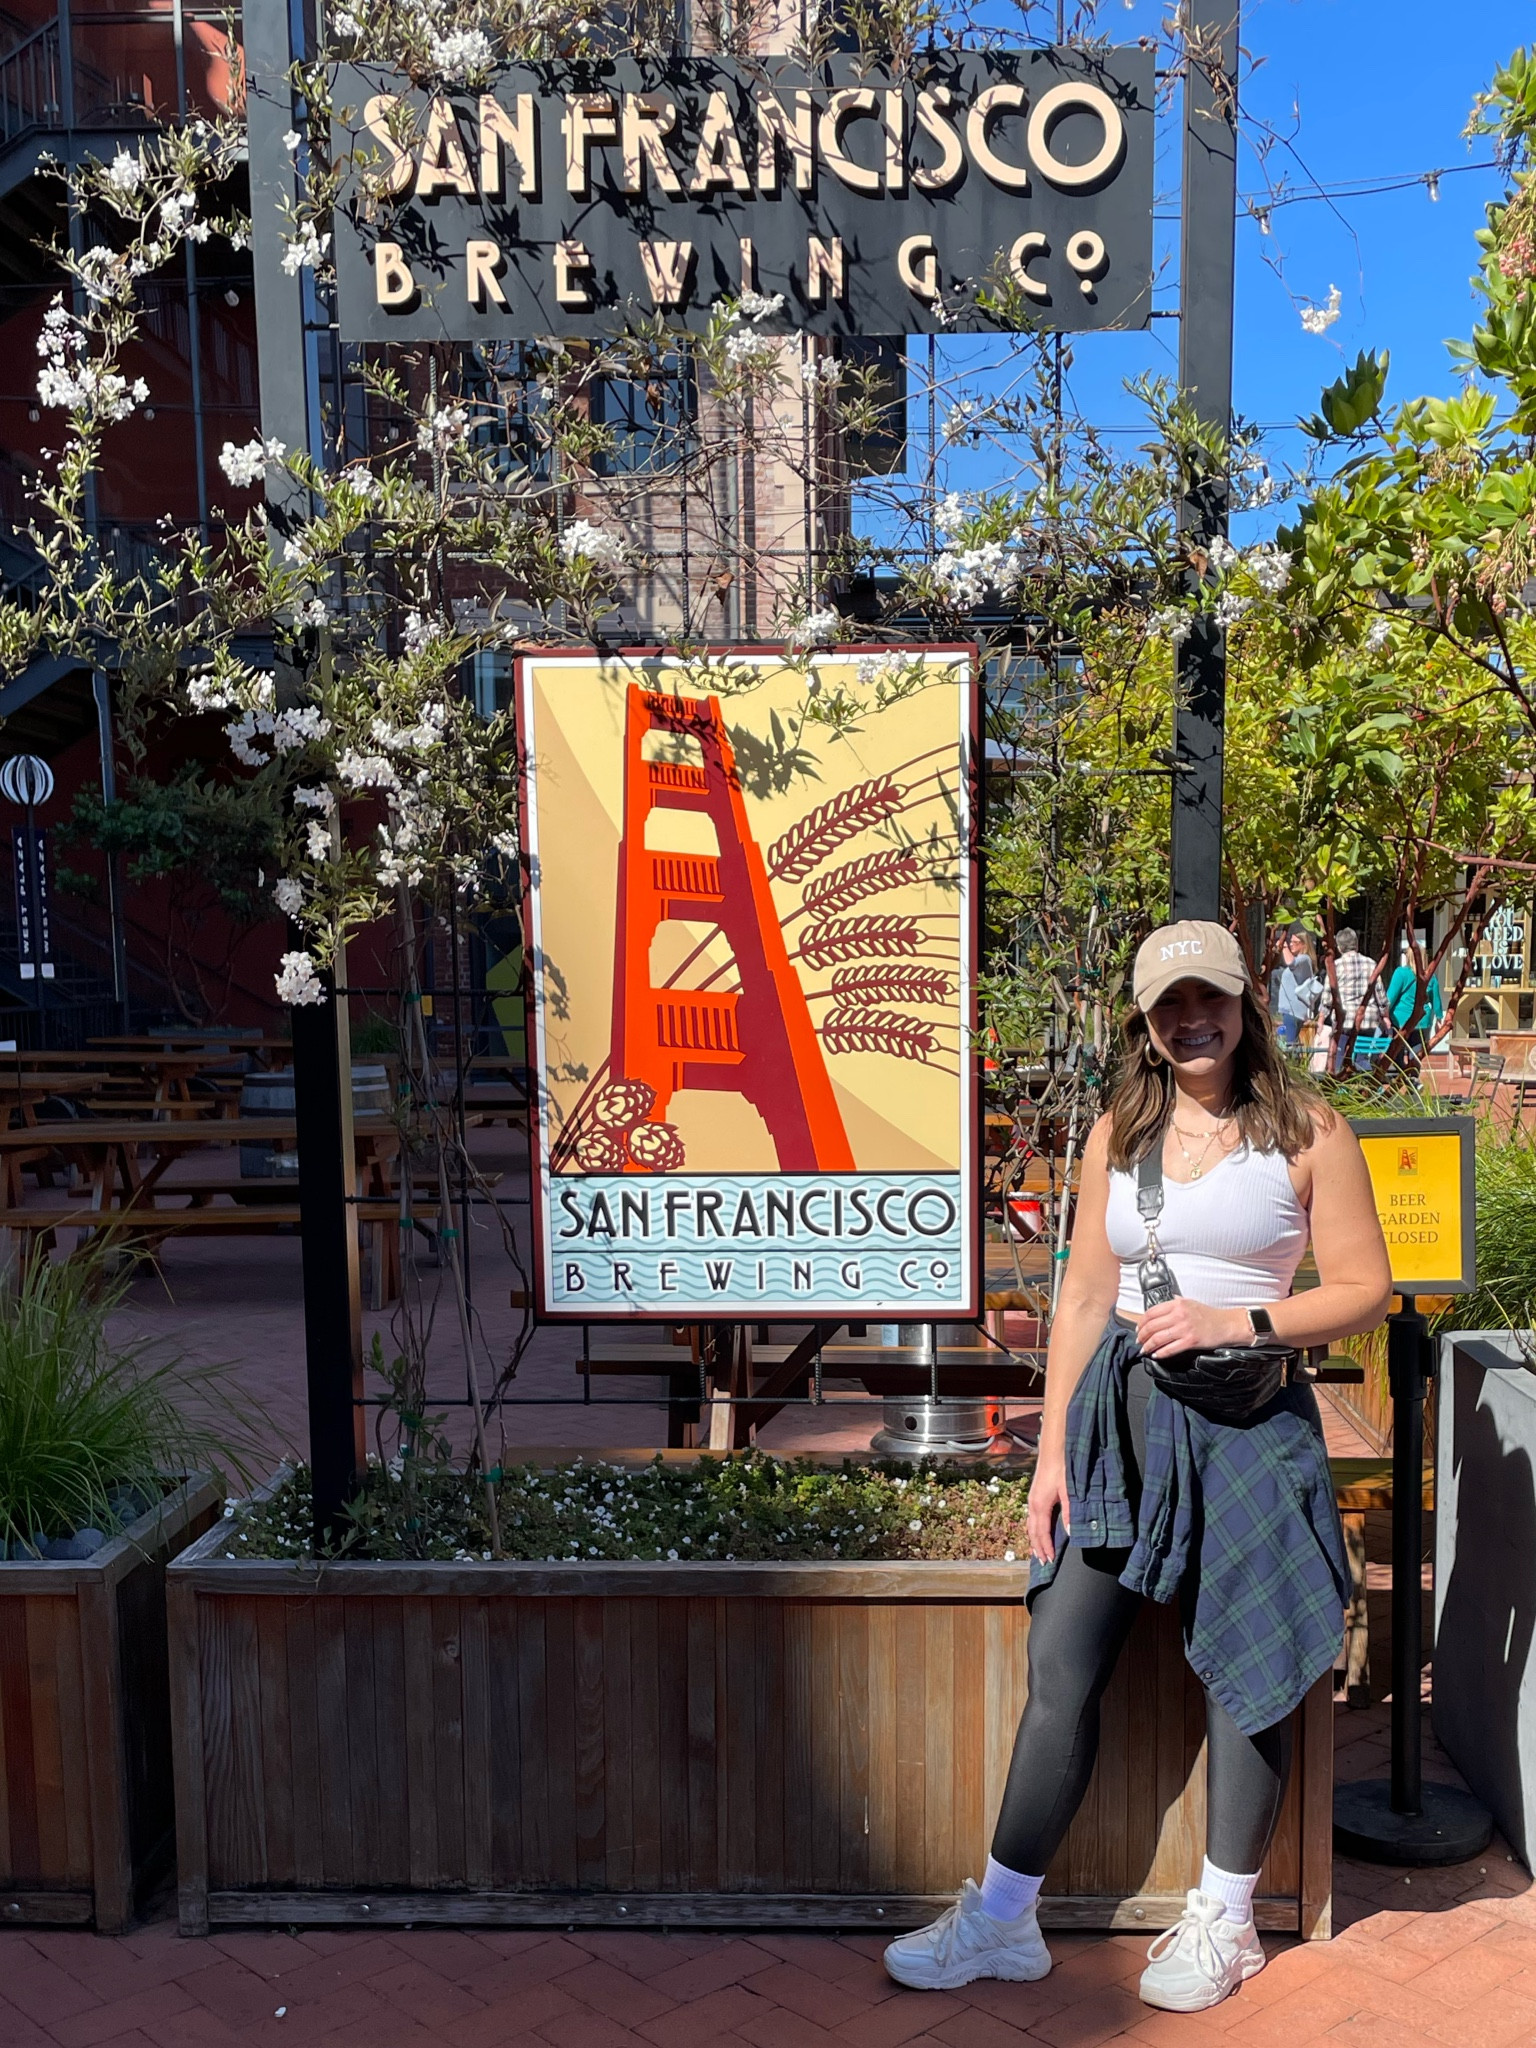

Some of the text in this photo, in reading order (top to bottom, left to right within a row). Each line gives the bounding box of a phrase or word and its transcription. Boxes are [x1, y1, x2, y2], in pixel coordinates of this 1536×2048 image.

[362, 80, 1124, 195] SAN FRANCISCO
[374, 233, 938, 304] BREWING
[17, 836, 29, 954] WEST PLAZA
[1160, 940, 1203, 961] NYC
[559, 1188, 957, 1238] SAN FRANCISCO
[1378, 1213, 1440, 1225] GARDEN
[1390, 1194, 1426, 1206] BEER
[566, 1260, 861, 1291] BREWING
